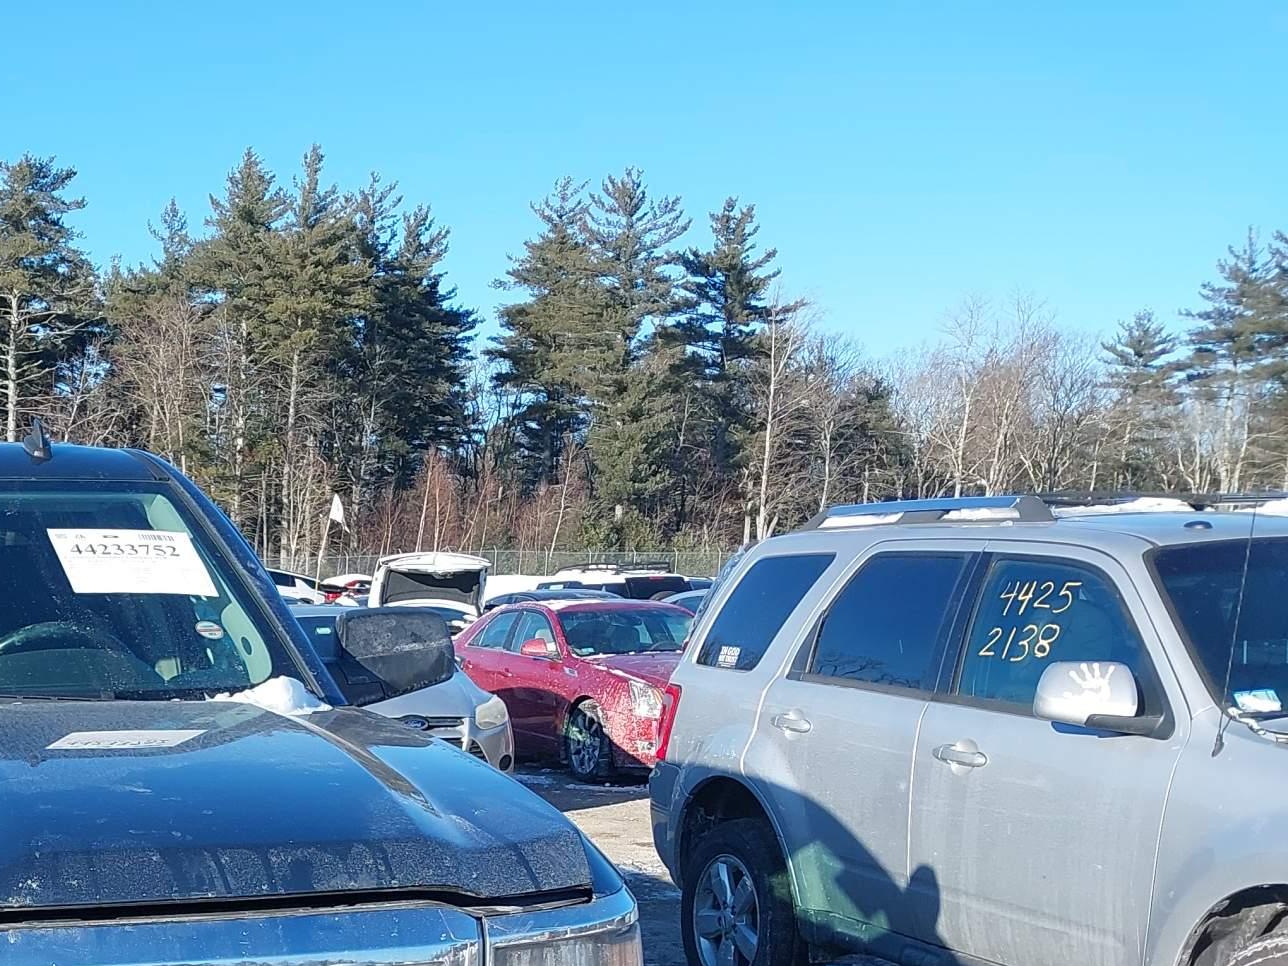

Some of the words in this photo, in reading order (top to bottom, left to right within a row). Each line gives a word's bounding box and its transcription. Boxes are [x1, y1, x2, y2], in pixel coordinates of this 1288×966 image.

[70, 543, 180, 557] 44233752
[1000, 580, 1083, 616] 4425
[978, 623, 1060, 662] 2138
